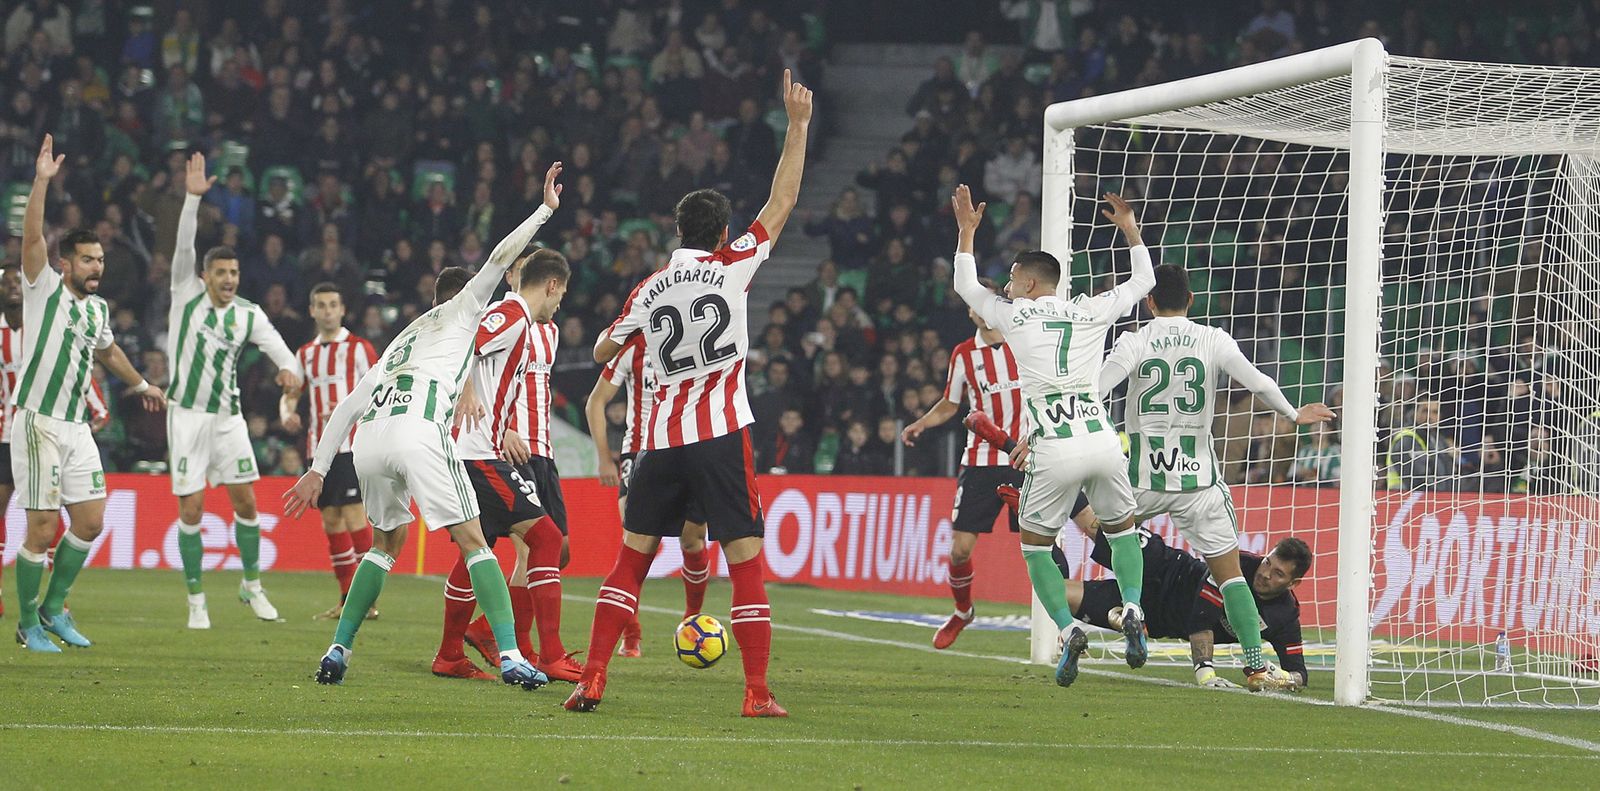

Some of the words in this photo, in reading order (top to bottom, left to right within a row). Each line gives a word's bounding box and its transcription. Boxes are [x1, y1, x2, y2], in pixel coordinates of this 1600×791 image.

[642, 278, 673, 309] RAÚL
[674, 268, 725, 289] GARCÍA
[1012, 307, 1059, 326] SER
[1064, 310, 1096, 322] LE
[650, 293, 738, 377] 22
[1042, 321, 1073, 377] 7
[1150, 334, 1197, 353] MANDI
[1138, 356, 1206, 416] 23
[1045, 395, 1099, 424] Wiko
[177, 456, 188, 476] 4
[1149, 447, 1201, 472] Wiko
[51, 465, 61, 487] 5
[765, 489, 952, 584] ORTIUM.e
